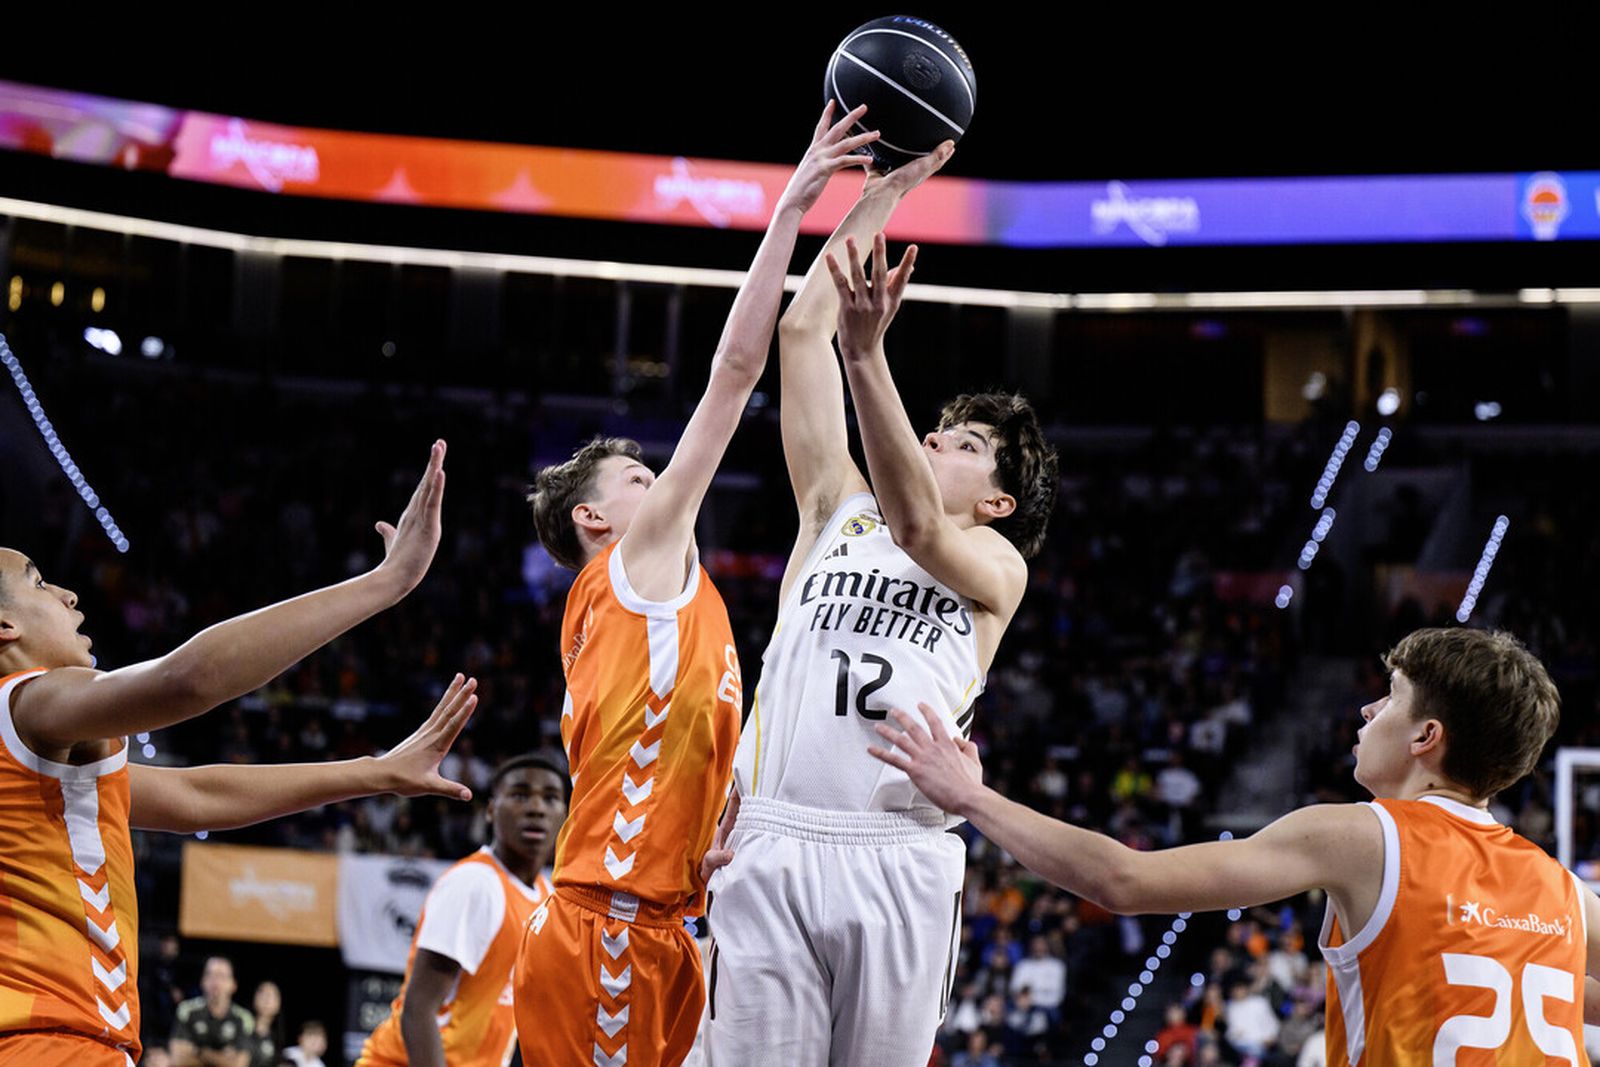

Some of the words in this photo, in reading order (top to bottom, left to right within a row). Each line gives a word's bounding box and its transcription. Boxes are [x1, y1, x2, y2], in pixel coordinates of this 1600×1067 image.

[800, 568, 971, 636] Emirates
[810, 603, 851, 631] FLY
[853, 606, 943, 653] BETTER
[830, 648, 894, 721] 12
[1483, 907, 1566, 937] CaixaBank
[1433, 953, 1579, 1067] 25
